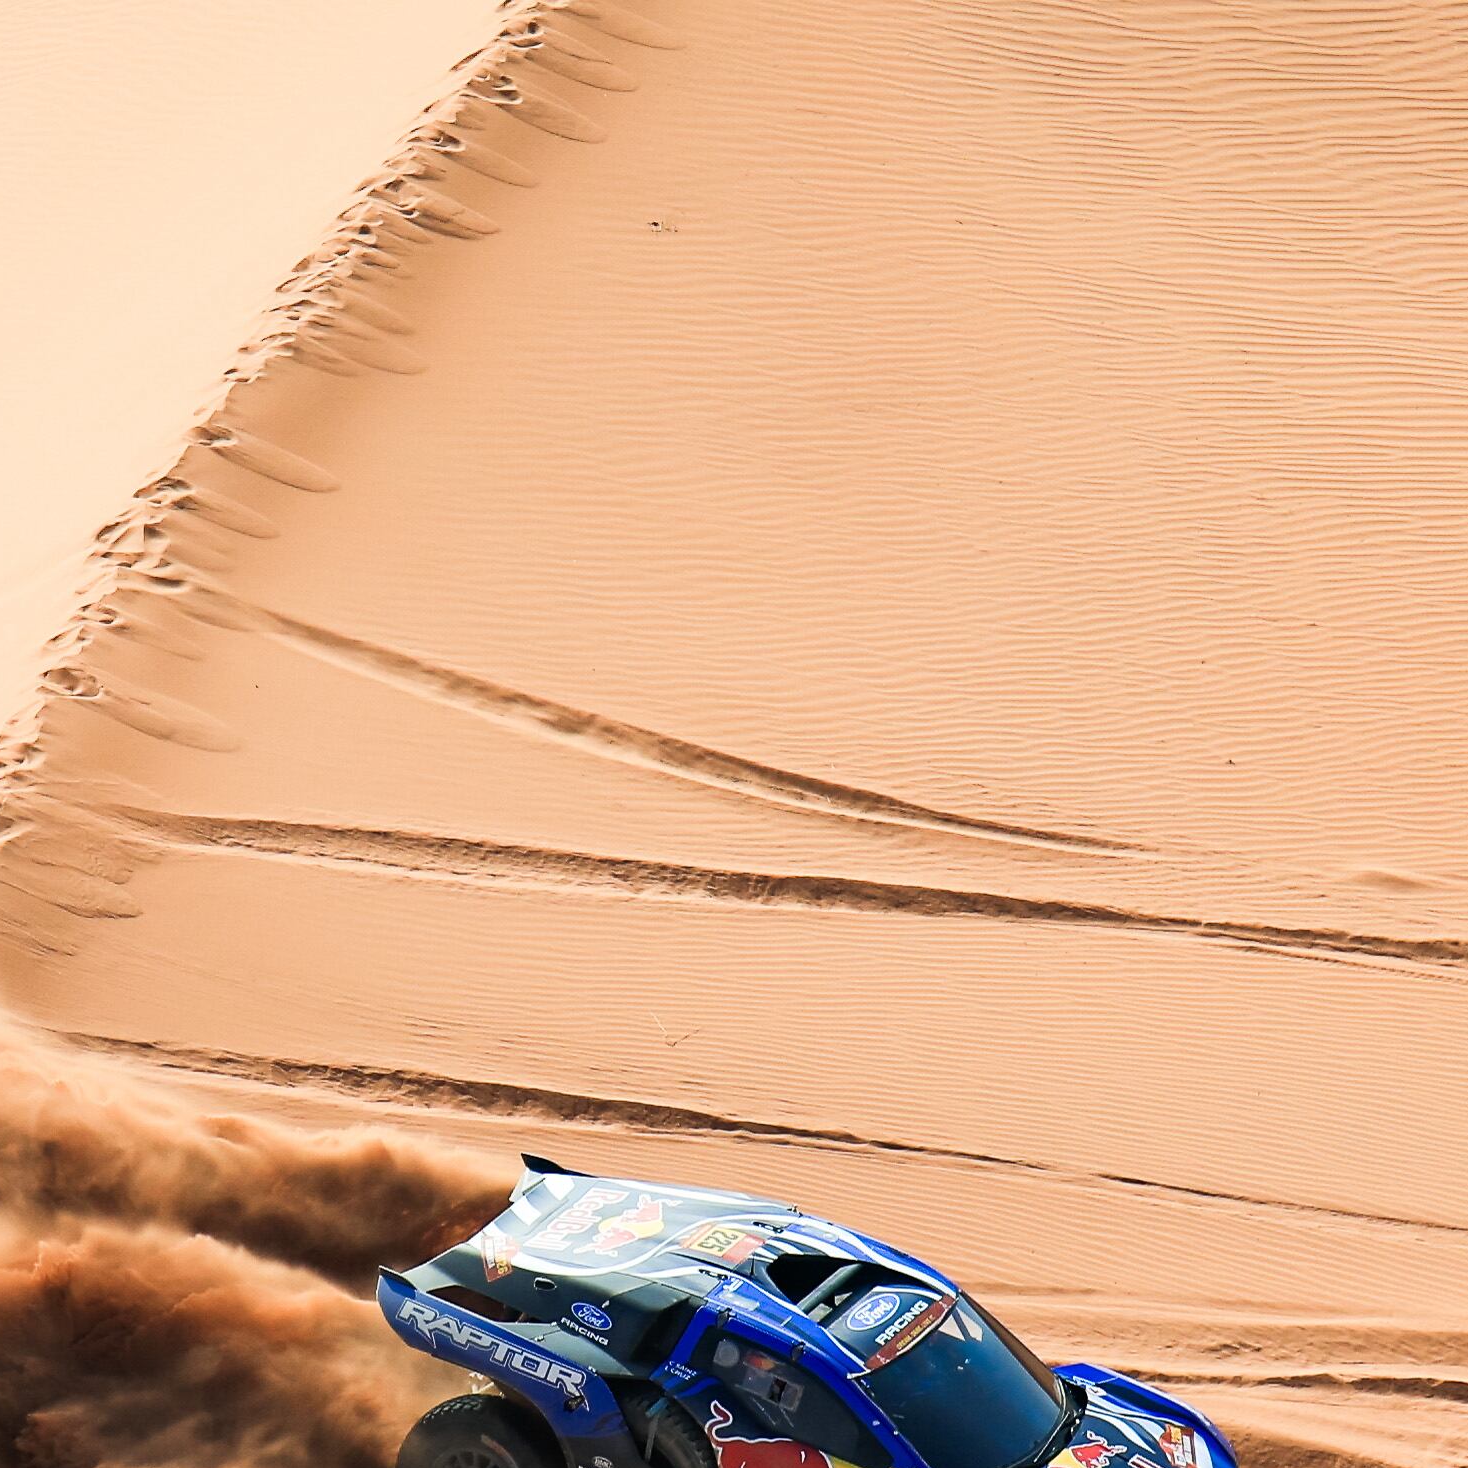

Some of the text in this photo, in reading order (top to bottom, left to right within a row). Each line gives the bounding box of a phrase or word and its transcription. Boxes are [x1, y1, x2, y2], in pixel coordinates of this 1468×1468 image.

[697, 1230, 738, 1252] 225
[576, 1305, 605, 1329] Ford
[853, 1298, 894, 1327] Ford
[875, 1300, 929, 1346] RACING
[560, 1317, 609, 1346] RACING
[396, 1298, 589, 1411] RAPTOR
